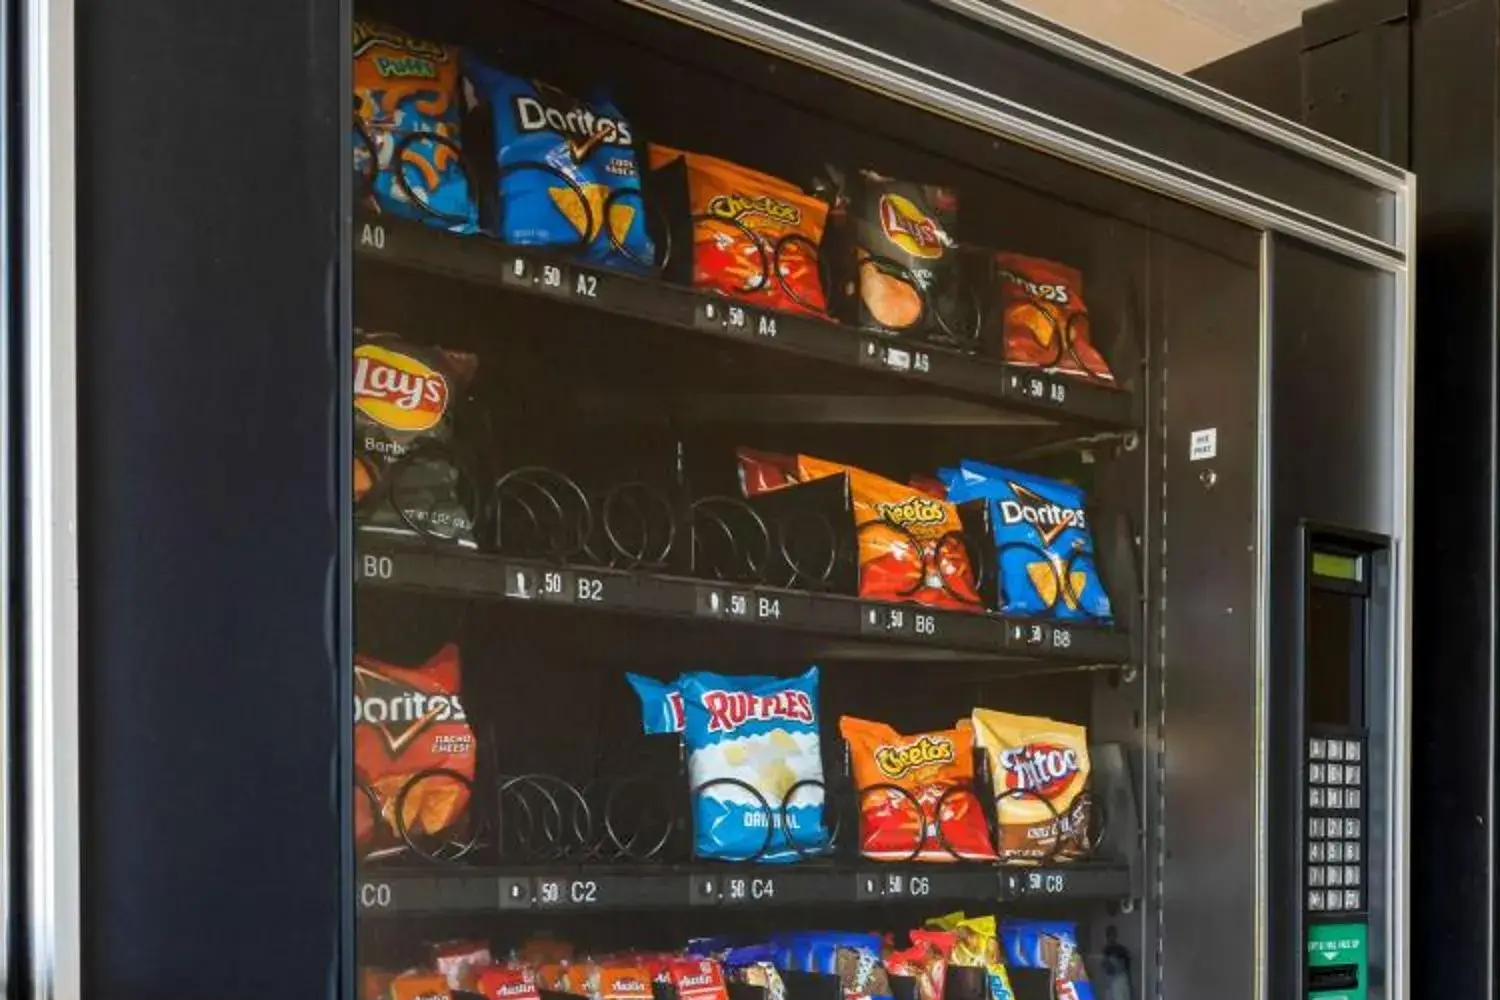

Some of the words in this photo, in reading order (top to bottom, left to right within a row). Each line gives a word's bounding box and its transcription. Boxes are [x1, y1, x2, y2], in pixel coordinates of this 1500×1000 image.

[517, 97, 632, 145] Doritos
[361, 223, 385, 249] A0
[576, 274, 598, 297] A2
[759, 316, 777, 337] A4
[1001, 501, 1086, 529] Doritos
[364, 555, 393, 579] B0
[579, 579, 603, 601] B2
[759, 598, 781, 619] B4
[915, 614, 935, 634] B6
[705, 690, 814, 732] RUFFLES
[876, 737, 953, 777] Cheetos
[361, 883, 392, 906] C0
[571, 881, 597, 903] C2
[752, 879, 775, 899] C4
[909, 876, 930, 896] C6
[1045, 875, 1064, 893] C8
[497, 982, 536, 996] Austin
